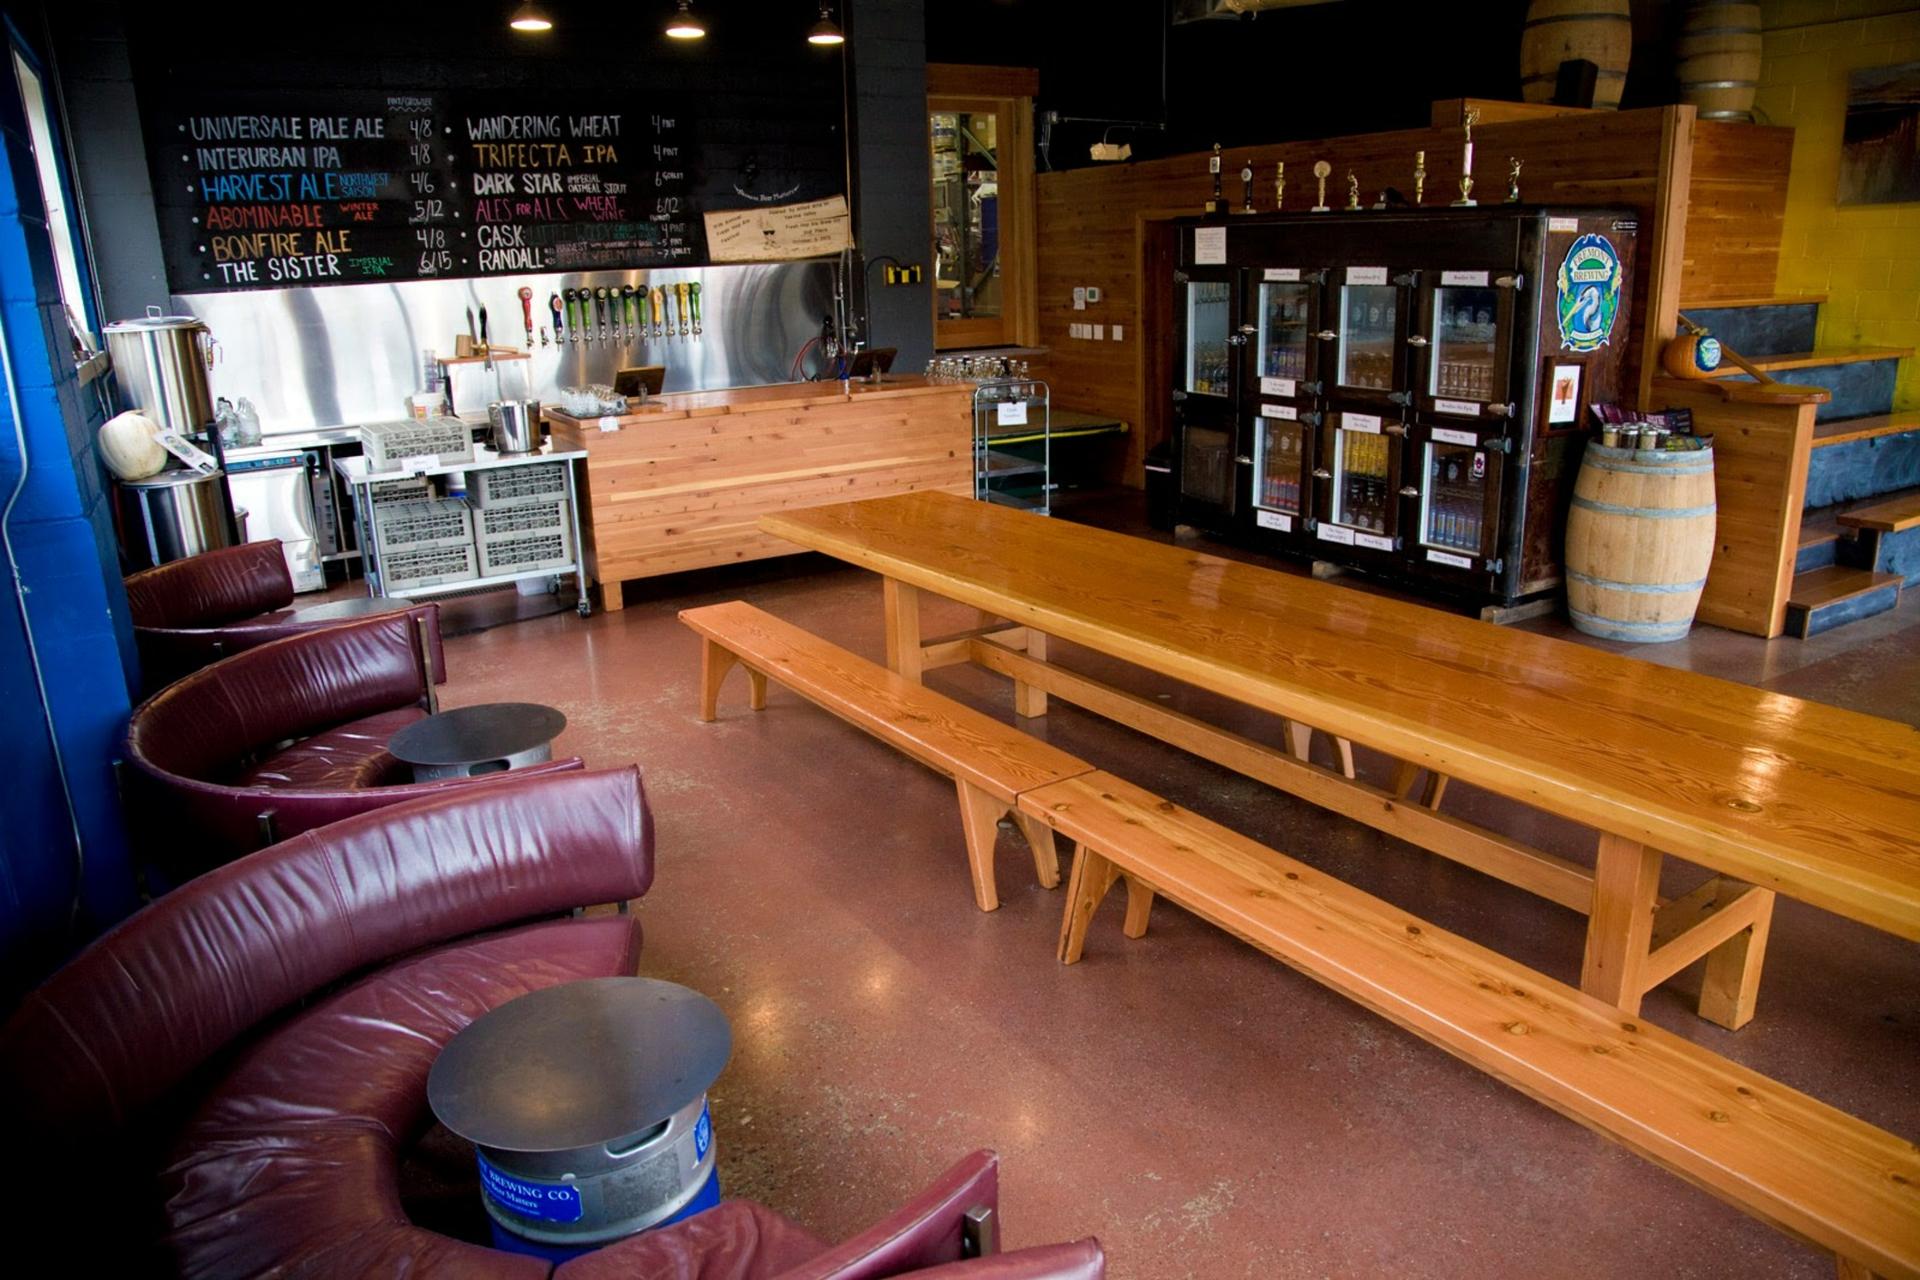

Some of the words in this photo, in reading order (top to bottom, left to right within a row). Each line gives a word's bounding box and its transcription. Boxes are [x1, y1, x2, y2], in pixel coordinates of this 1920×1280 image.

[190, 115, 303, 141] UNIVERSALE
[309, 116, 349, 139] PALE
[354, 117, 385, 139] ALE
[409, 118, 433, 142] 4/8
[466, 115, 561, 140] WANDERING
[568, 114, 622, 138] WHEAT
[651, 114, 661, 134] 4
[196, 147, 306, 171] INTERURBAN
[313, 147, 342, 169] IPA
[409, 145, 431, 167] 4/8
[471, 143, 572, 168] TRIFECTA
[583, 144, 619, 165] IPA
[652, 144, 662, 161] 4
[201, 174, 293, 203] HARVEST
[300, 173, 341, 201] ALE
[472, 173, 515, 195] DARK
[522, 172, 564, 194] STAR
[568, 183, 601, 194] OATMEAL
[604, 183, 627, 194] STOUT
[206, 204, 324, 230] ABOMINABLE
[339, 202, 380, 213] WINTER
[353, 211, 374, 221] ALE
[475, 197, 512, 223] ALES
[515, 203, 532, 215] FOR
[573, 195, 618, 212] WHEAT
[591, 209, 627, 221] WINE
[211, 232, 305, 262] BONFIRE
[315, 230, 352, 254] ALE
[416, 230, 446, 251] 4/8
[478, 246, 545, 272] RANDALL
[1573, 248, 1610, 267] FREMONT
[217, 260, 259, 284] THE
[267, 257, 342, 279] SISTER
[1573, 270, 1609, 280] BREWING
[489, 1169, 543, 1199] BREWING
[547, 1190, 574, 1201] CO.
